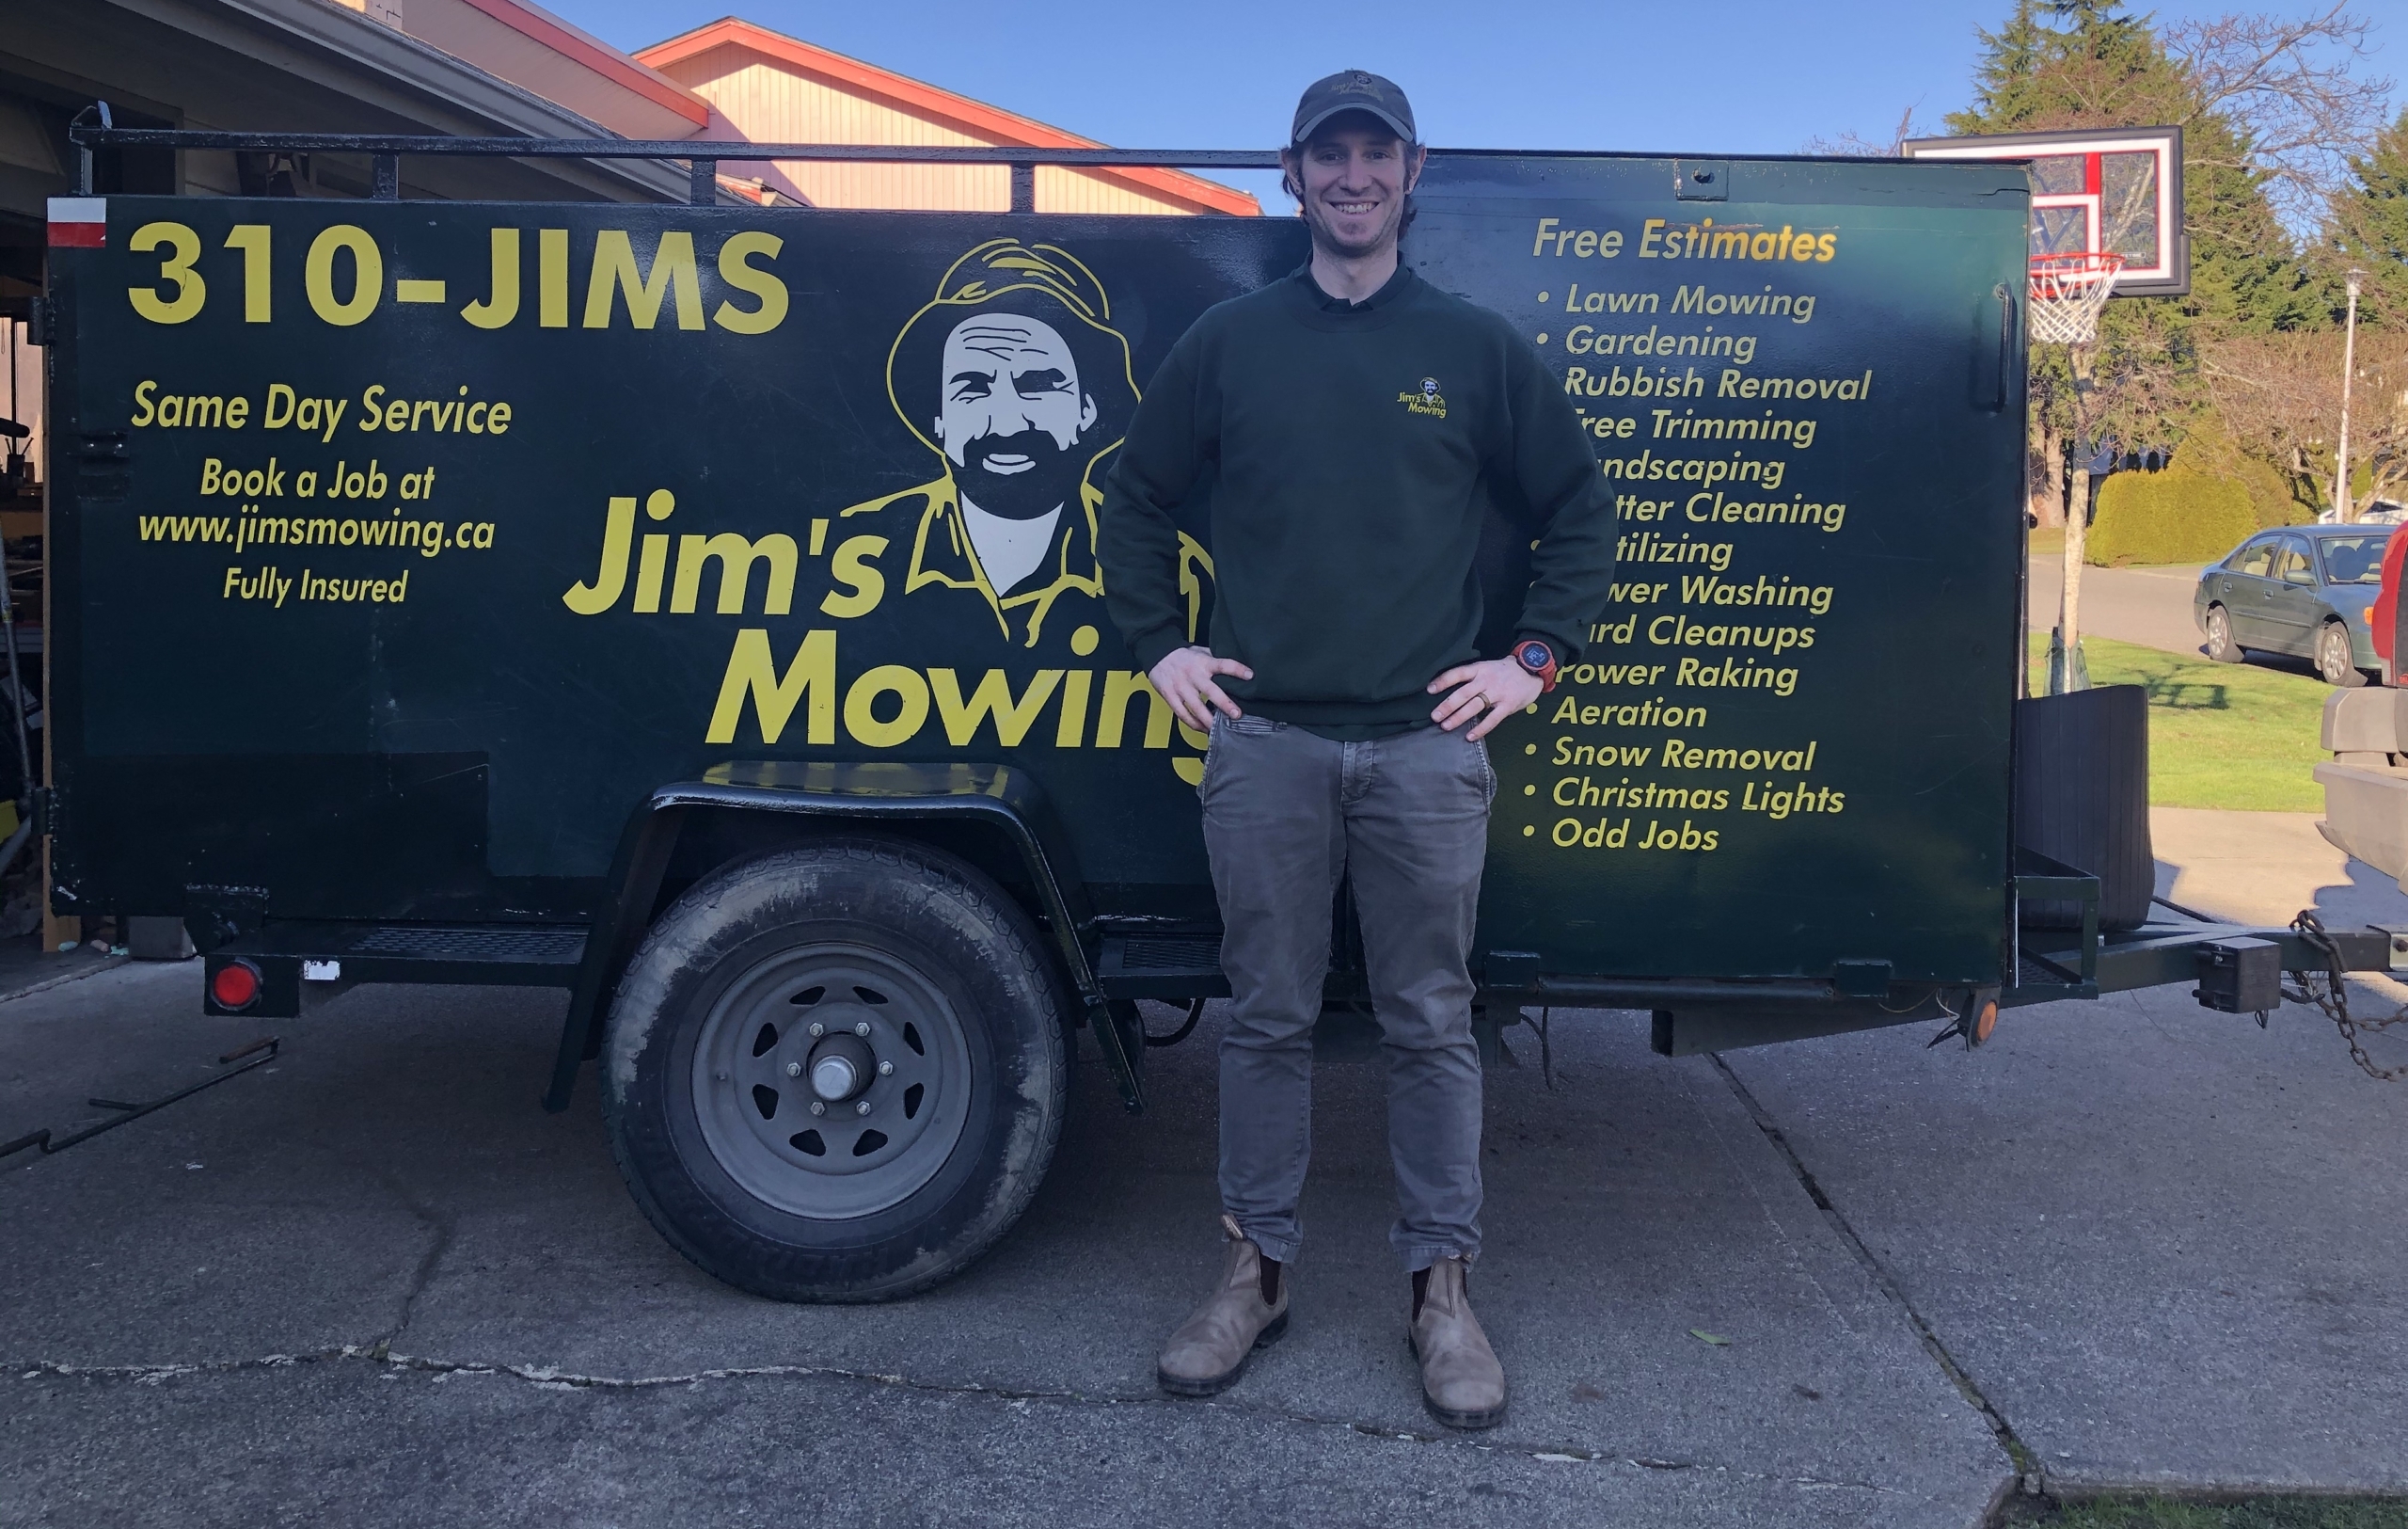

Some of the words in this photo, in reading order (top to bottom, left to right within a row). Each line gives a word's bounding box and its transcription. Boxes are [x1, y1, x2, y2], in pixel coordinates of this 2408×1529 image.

[1533, 217, 1624, 259] Free
[1639, 217, 1837, 263] Estimates
[129, 222, 789, 335] 310-JIMS
[1566, 284, 1659, 313] Lawn
[1671, 285, 1816, 324] Mowing
[1566, 326, 1757, 365] Gardening
[1397, 391, 1421, 403] Jim's
[1564, 366, 1704, 397] Rubbish
[1718, 370, 1873, 401] Removal
[132, 381, 249, 429] Same
[264, 384, 347, 443] Day
[360, 385, 513, 436] Service
[1408, 402, 1447, 419] Mowing
[1652, 409, 1817, 449] Trimming
[200, 458, 286, 498] Book
[297, 471, 318, 499] a
[326, 461, 388, 501] Job
[401, 468, 436, 501] at
[1596, 449, 1785, 488] ndscaping
[139, 505, 496, 558] www.jimsmowing.ca
[1616, 494, 1674, 522] tter
[1685, 492, 1846, 533] Cleaning
[562, 488, 891, 619] Jim's
[1616, 532, 1734, 571] tilizing
[224, 567, 293, 608] Fully
[301, 570, 408, 604] Insured
[1607, 582, 1669, 605] wer
[1682, 574, 1833, 615] Washing
[1588, 613, 1638, 645] rd
[1648, 614, 1816, 656] Cleanups
[1676, 658, 1798, 696] Raking
[1551, 696, 1707, 727] Aeration
[1552, 737, 1652, 768] Snow
[1661, 740, 1817, 772] Removal
[1553, 777, 1730, 810] Christmas
[1742, 781, 1846, 820] Lights
[1552, 818, 1630, 849] Odd
[1639, 820, 1719, 851] Jobs
